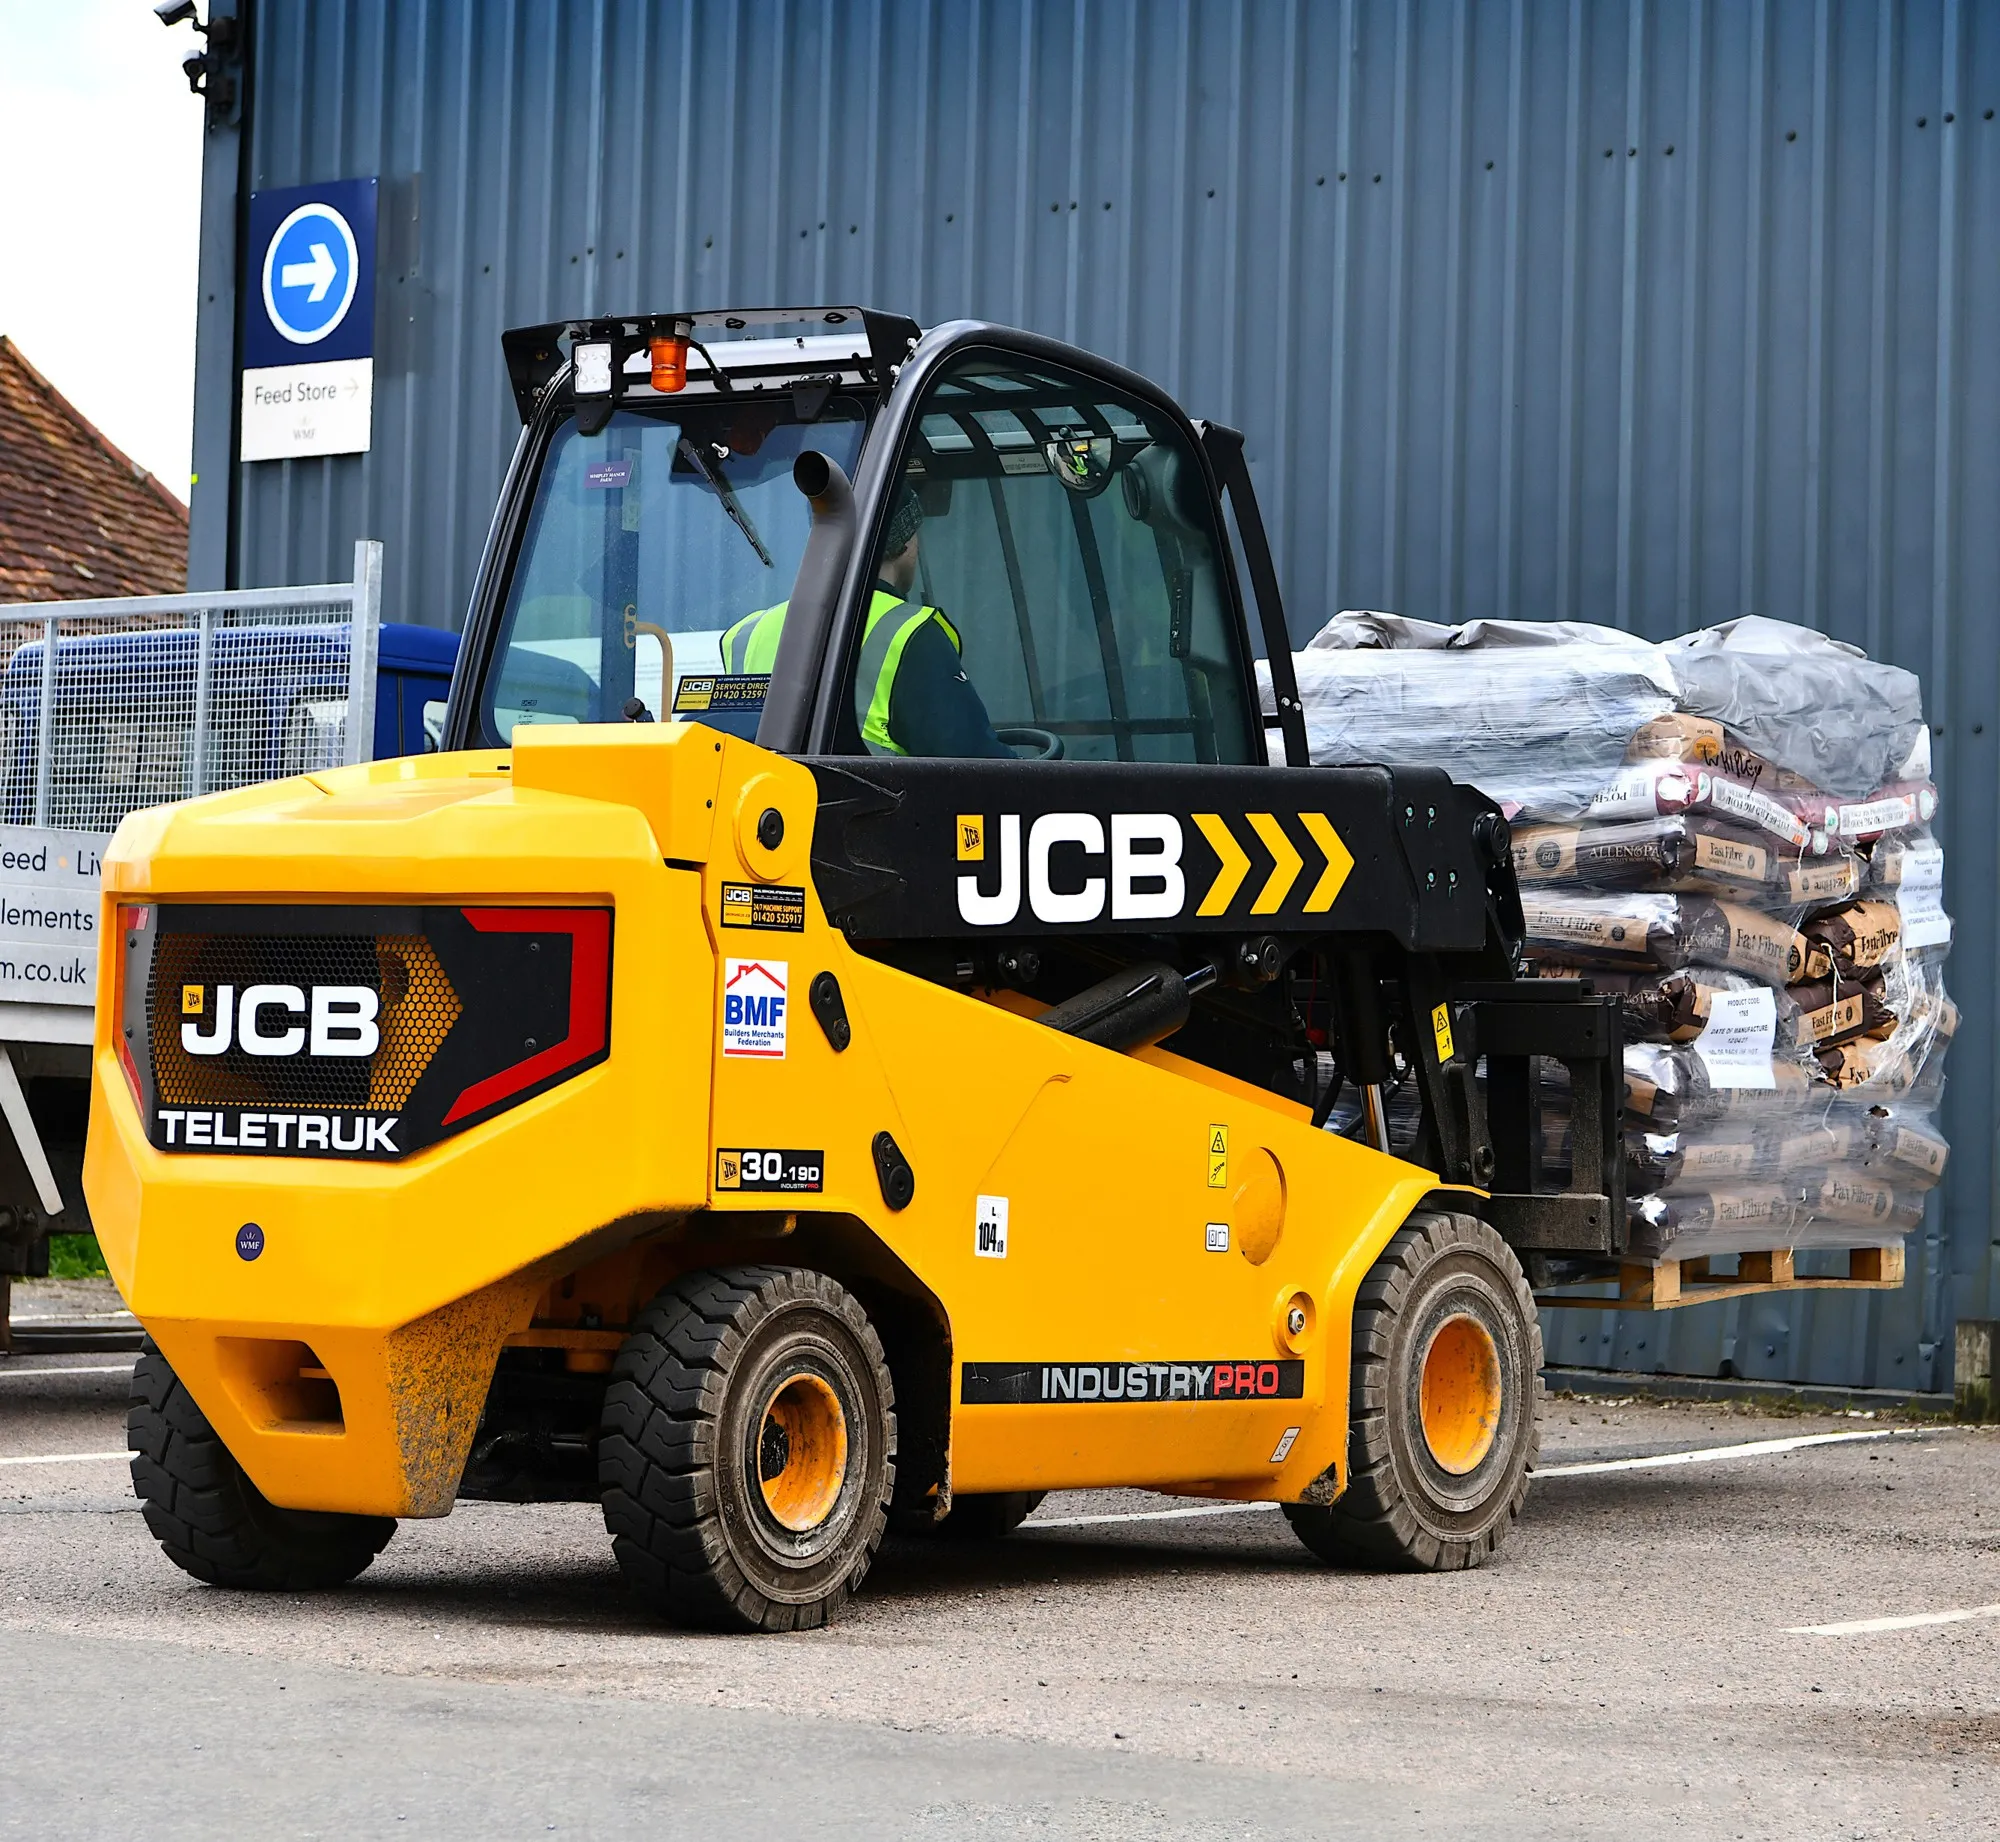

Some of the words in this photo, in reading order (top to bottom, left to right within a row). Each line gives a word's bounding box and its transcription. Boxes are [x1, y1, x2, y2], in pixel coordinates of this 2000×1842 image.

[254, 382, 292, 405] Feed
[297, 382, 337, 401] Store
[684, 681, 712, 691] JCB
[715, 683, 746, 691] SERVICE
[713, 691, 739, 699] 01420
[964, 827, 981, 849] JCB
[0, 844, 46, 872] eed
[957, 813, 1186, 926] JCB
[726, 890, 750, 902] JCB
[763, 904, 783, 912] MACHINE
[753, 912, 775, 923] 01420
[776, 914, 802, 924] 525917
[725, 994, 785, 1027] BMF
[181, 985, 380, 1056] JCB
[1811, 1014, 1825, 1029] Fast
[1825, 1009, 1842, 1025] Fire
[724, 1029, 750, 1037] Builders
[751, 1030, 784, 1039] Merchants
[1710, 1027, 1725, 1035] DATE
[737, 1038, 771, 1047] Federation
[158, 1110, 400, 1152] TELETRUK
[240, 1240, 260, 1250] WMF
[979, 1222, 997, 1252] 104
[1041, 1364, 1279, 1398] INDUSTRYPRO
